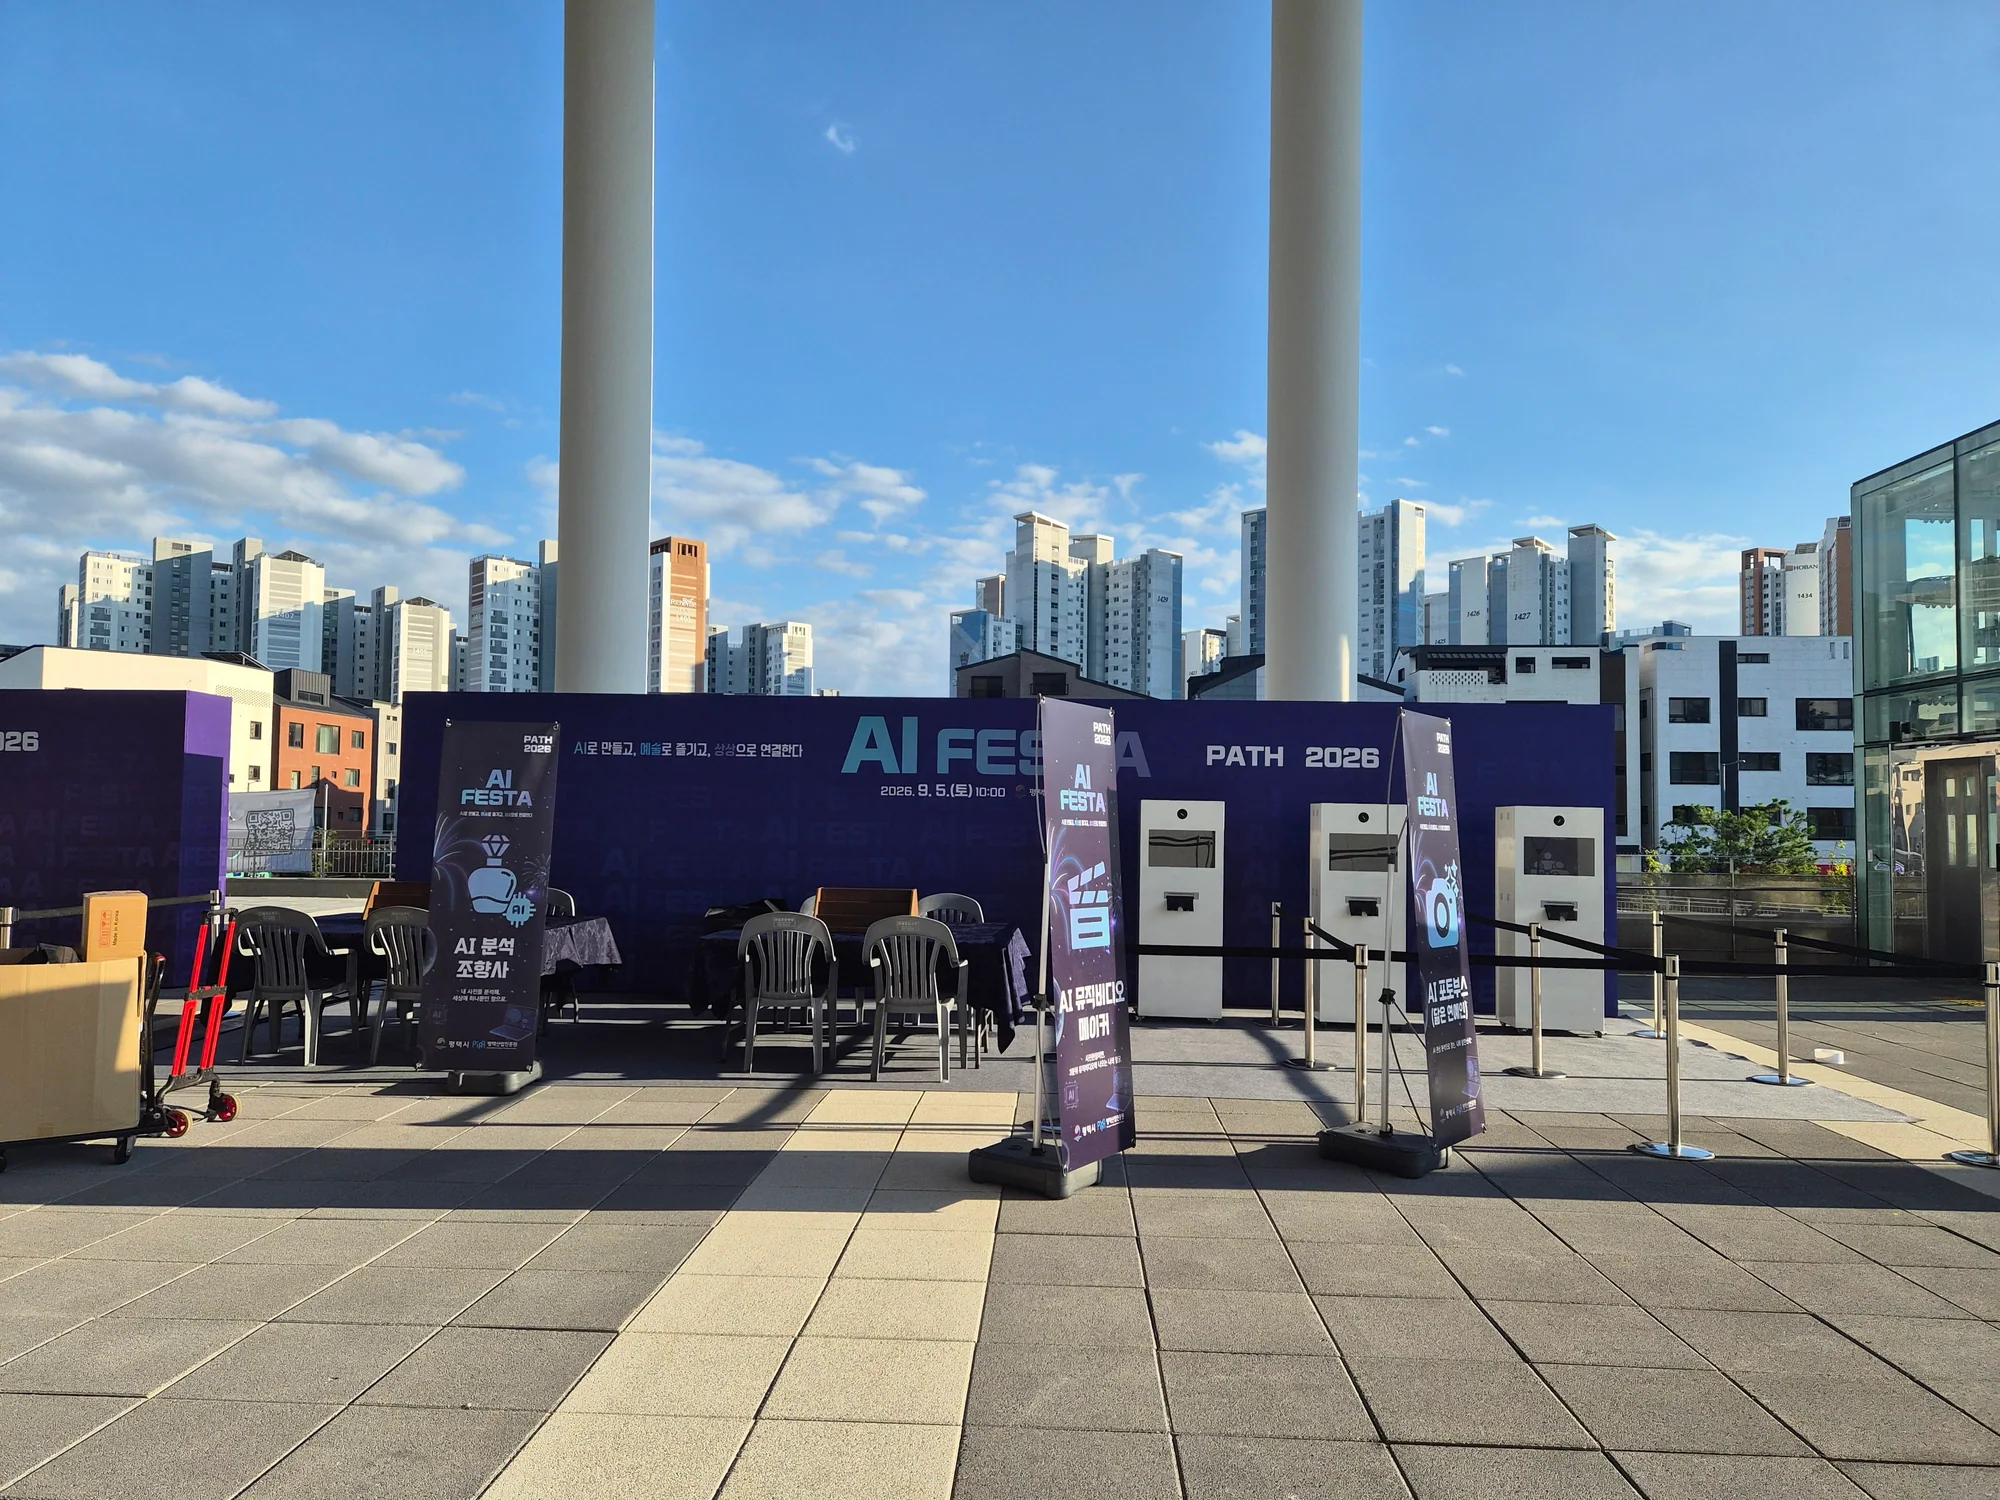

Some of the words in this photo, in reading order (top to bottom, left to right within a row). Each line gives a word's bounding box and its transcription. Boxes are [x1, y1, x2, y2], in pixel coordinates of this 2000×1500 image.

[1157, 595, 1169, 603] 1429
[275, 611, 295, 619] 1407
[1514, 612, 1531, 620] 1427
[1093, 721, 1111, 734] PATH
[0, 731, 39, 751] 26
[524, 735, 553, 744] PATH
[524, 745, 552, 753] 2026
[841, 716, 918, 774] AI
[937, 728, 1151, 778] FESA
[573, 741, 598, 755] AI로
[601, 741, 637, 757] 만들고,
[640, 742, 672, 756] 예술로
[675, 742, 711, 757] 즐기고,
[714, 743, 757, 757] 상상으로
[760, 743, 803, 758] 연결한다
[1206, 745, 1284, 767] PATH
[1305, 747, 1380, 769] 2026
[485, 769, 512, 788] AI
[1074, 763, 1092, 789] AI
[1427, 772, 1438, 796] AI
[461, 789, 533, 806] FESTA
[881, 786, 915, 797] 2026.
[918, 783, 932, 797] 9.
[975, 787, 1006, 798] 10:00
[1060, 789, 1106, 813] FESTA
[1418, 797, 1449, 818] FESTA
[511, 904, 525, 916] AI
[453, 937, 477, 955] AI
[481, 937, 515, 956] 분석
[456, 960, 510, 979] 조향사
[1059, 989, 1074, 1014] AI
[1075, 980, 1125, 1011] 뮤직비디오
[1428, 981, 1438, 1004] AI
[1438, 975, 1469, 1002] 포토부스
[1431, 1005, 1447, 1028] (닮은
[1447, 1000, 1468, 1023] 연예인)
[1078, 1012, 1110, 1042] 메이커
